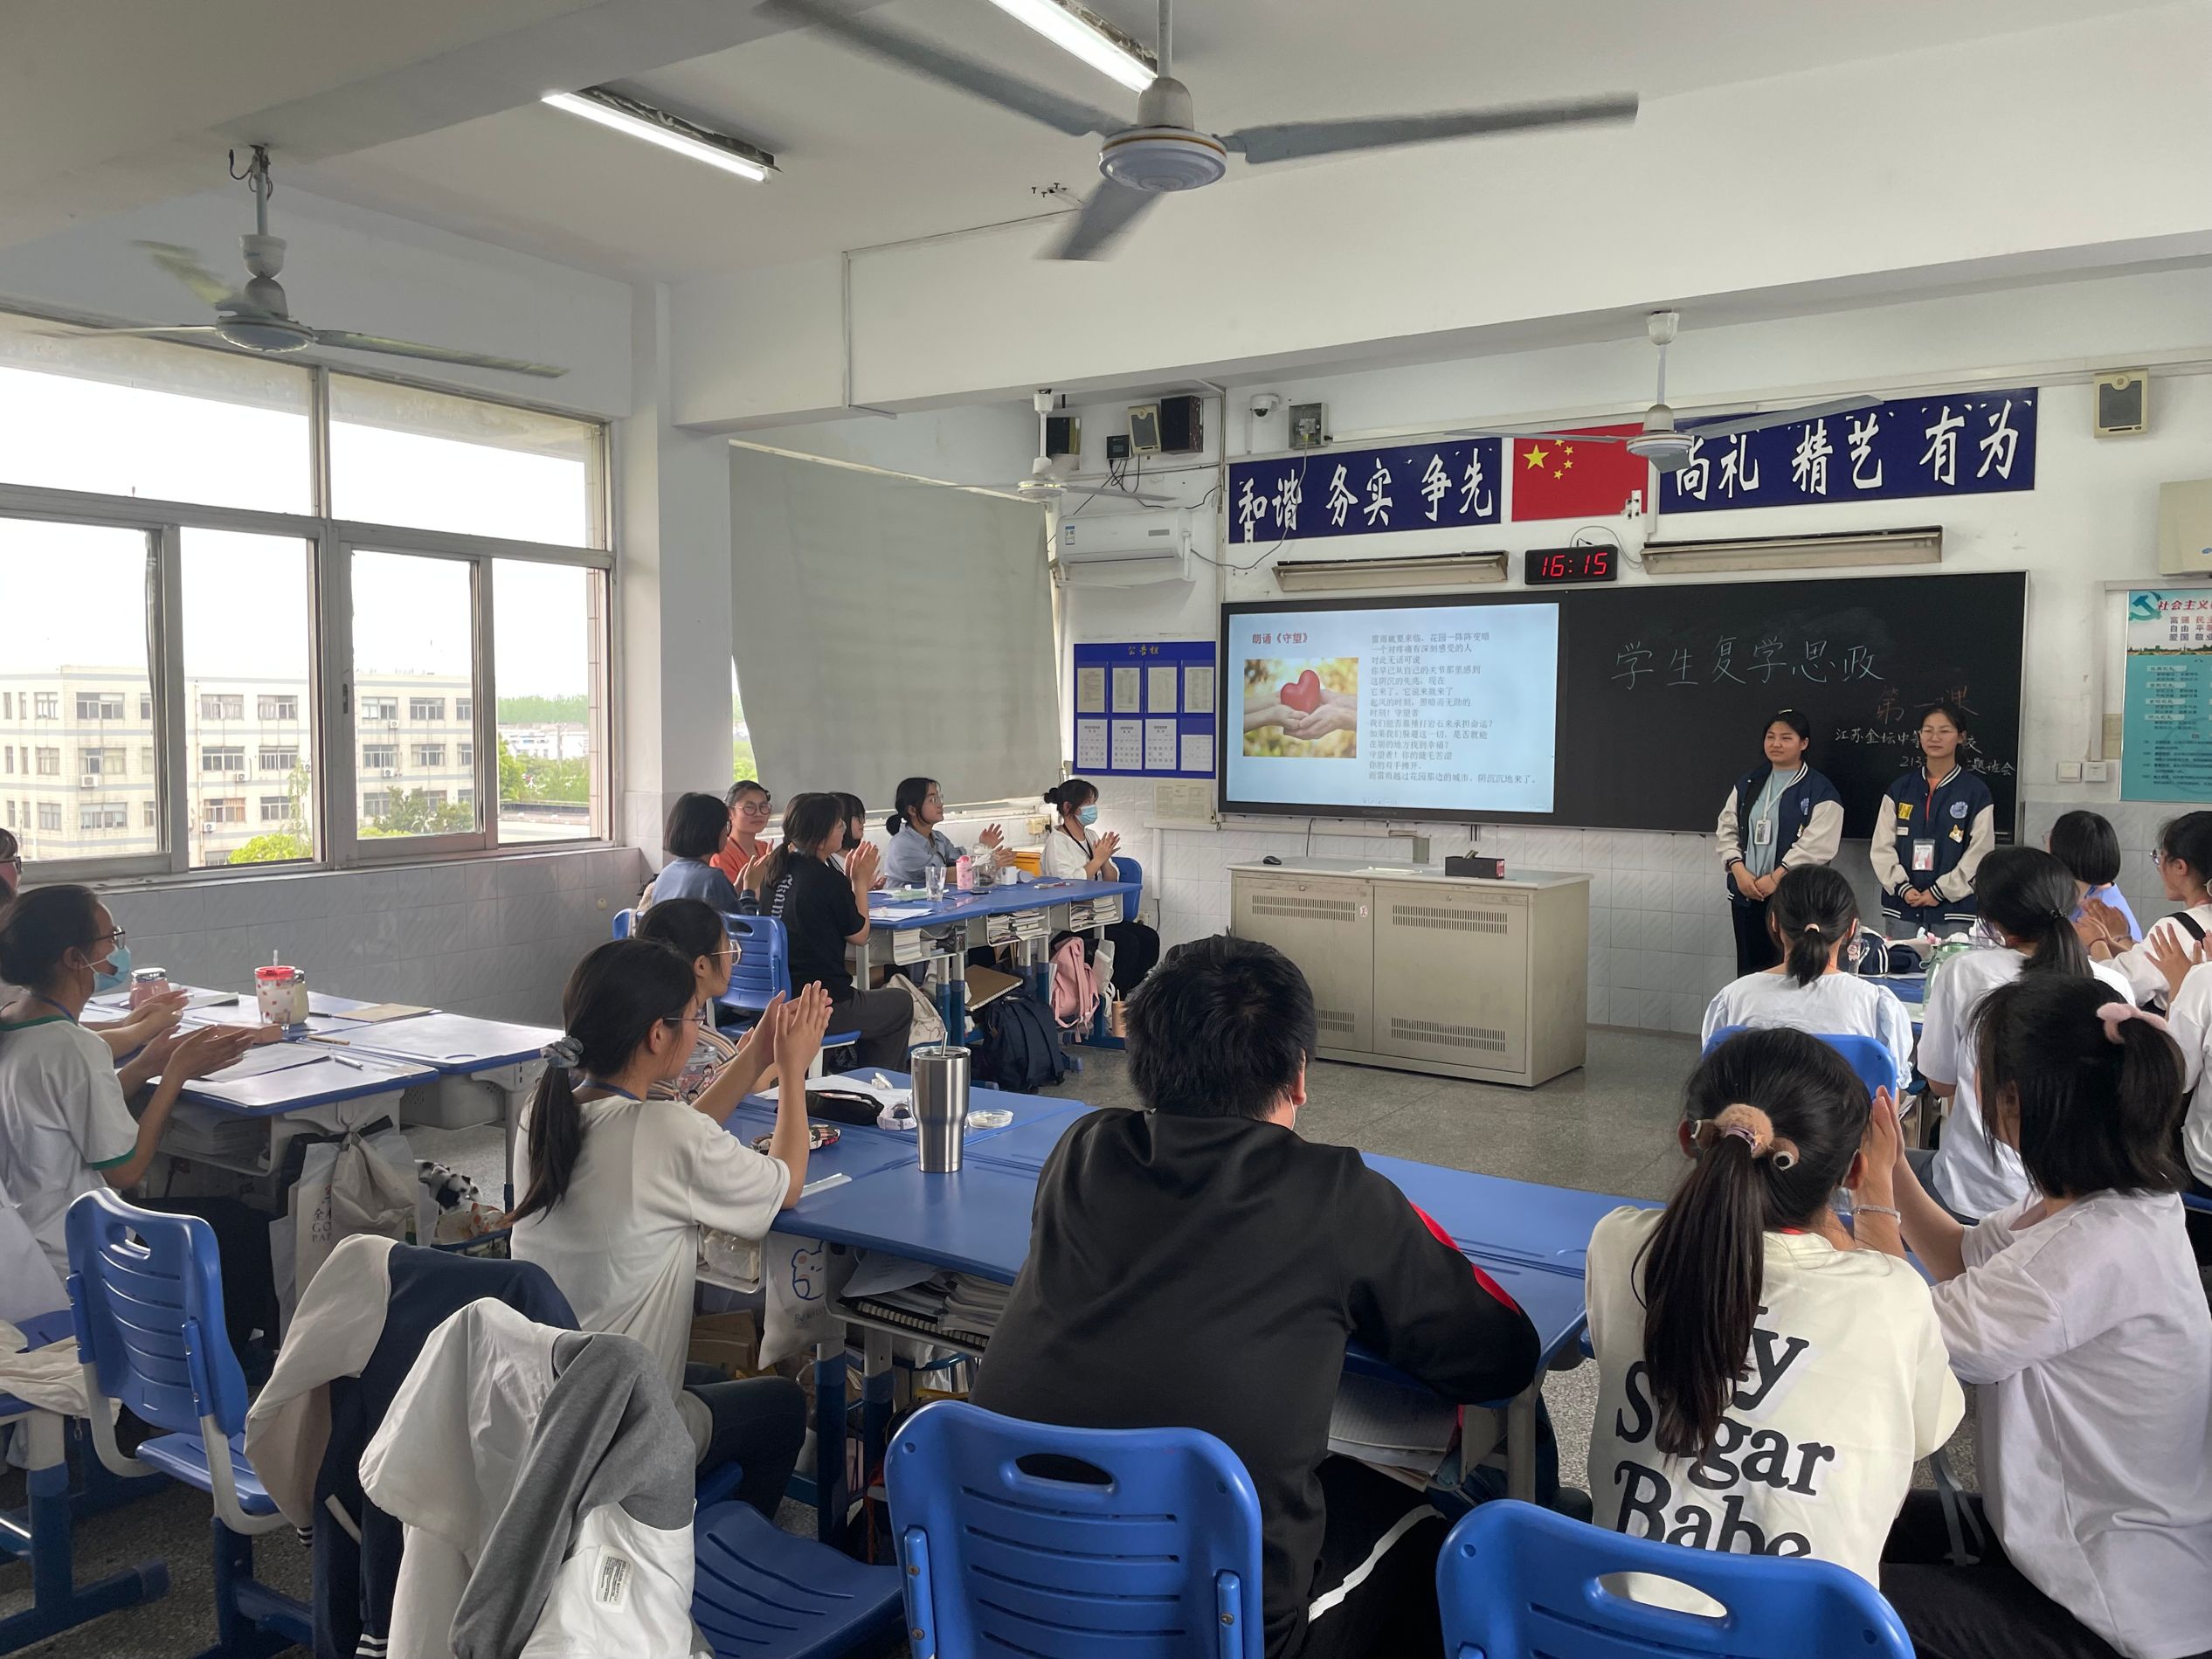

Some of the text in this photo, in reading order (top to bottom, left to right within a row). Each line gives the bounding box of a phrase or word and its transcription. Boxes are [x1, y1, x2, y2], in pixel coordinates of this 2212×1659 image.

[1676, 399, 2021, 501] 尚礼 精艺 有为
[1238, 448, 1493, 531] 和谐 务实 争先
[1542, 552, 1607, 577] 16:15
[2158, 599, 2212, 610] 社会主义
[1128, 645, 1160, 656] 公告栏
[1371, 655, 1421, 665] 对此无话可说
[1611, 636, 1886, 690] 学生复学思政
[1614, 1360, 1836, 1497] Sgar
